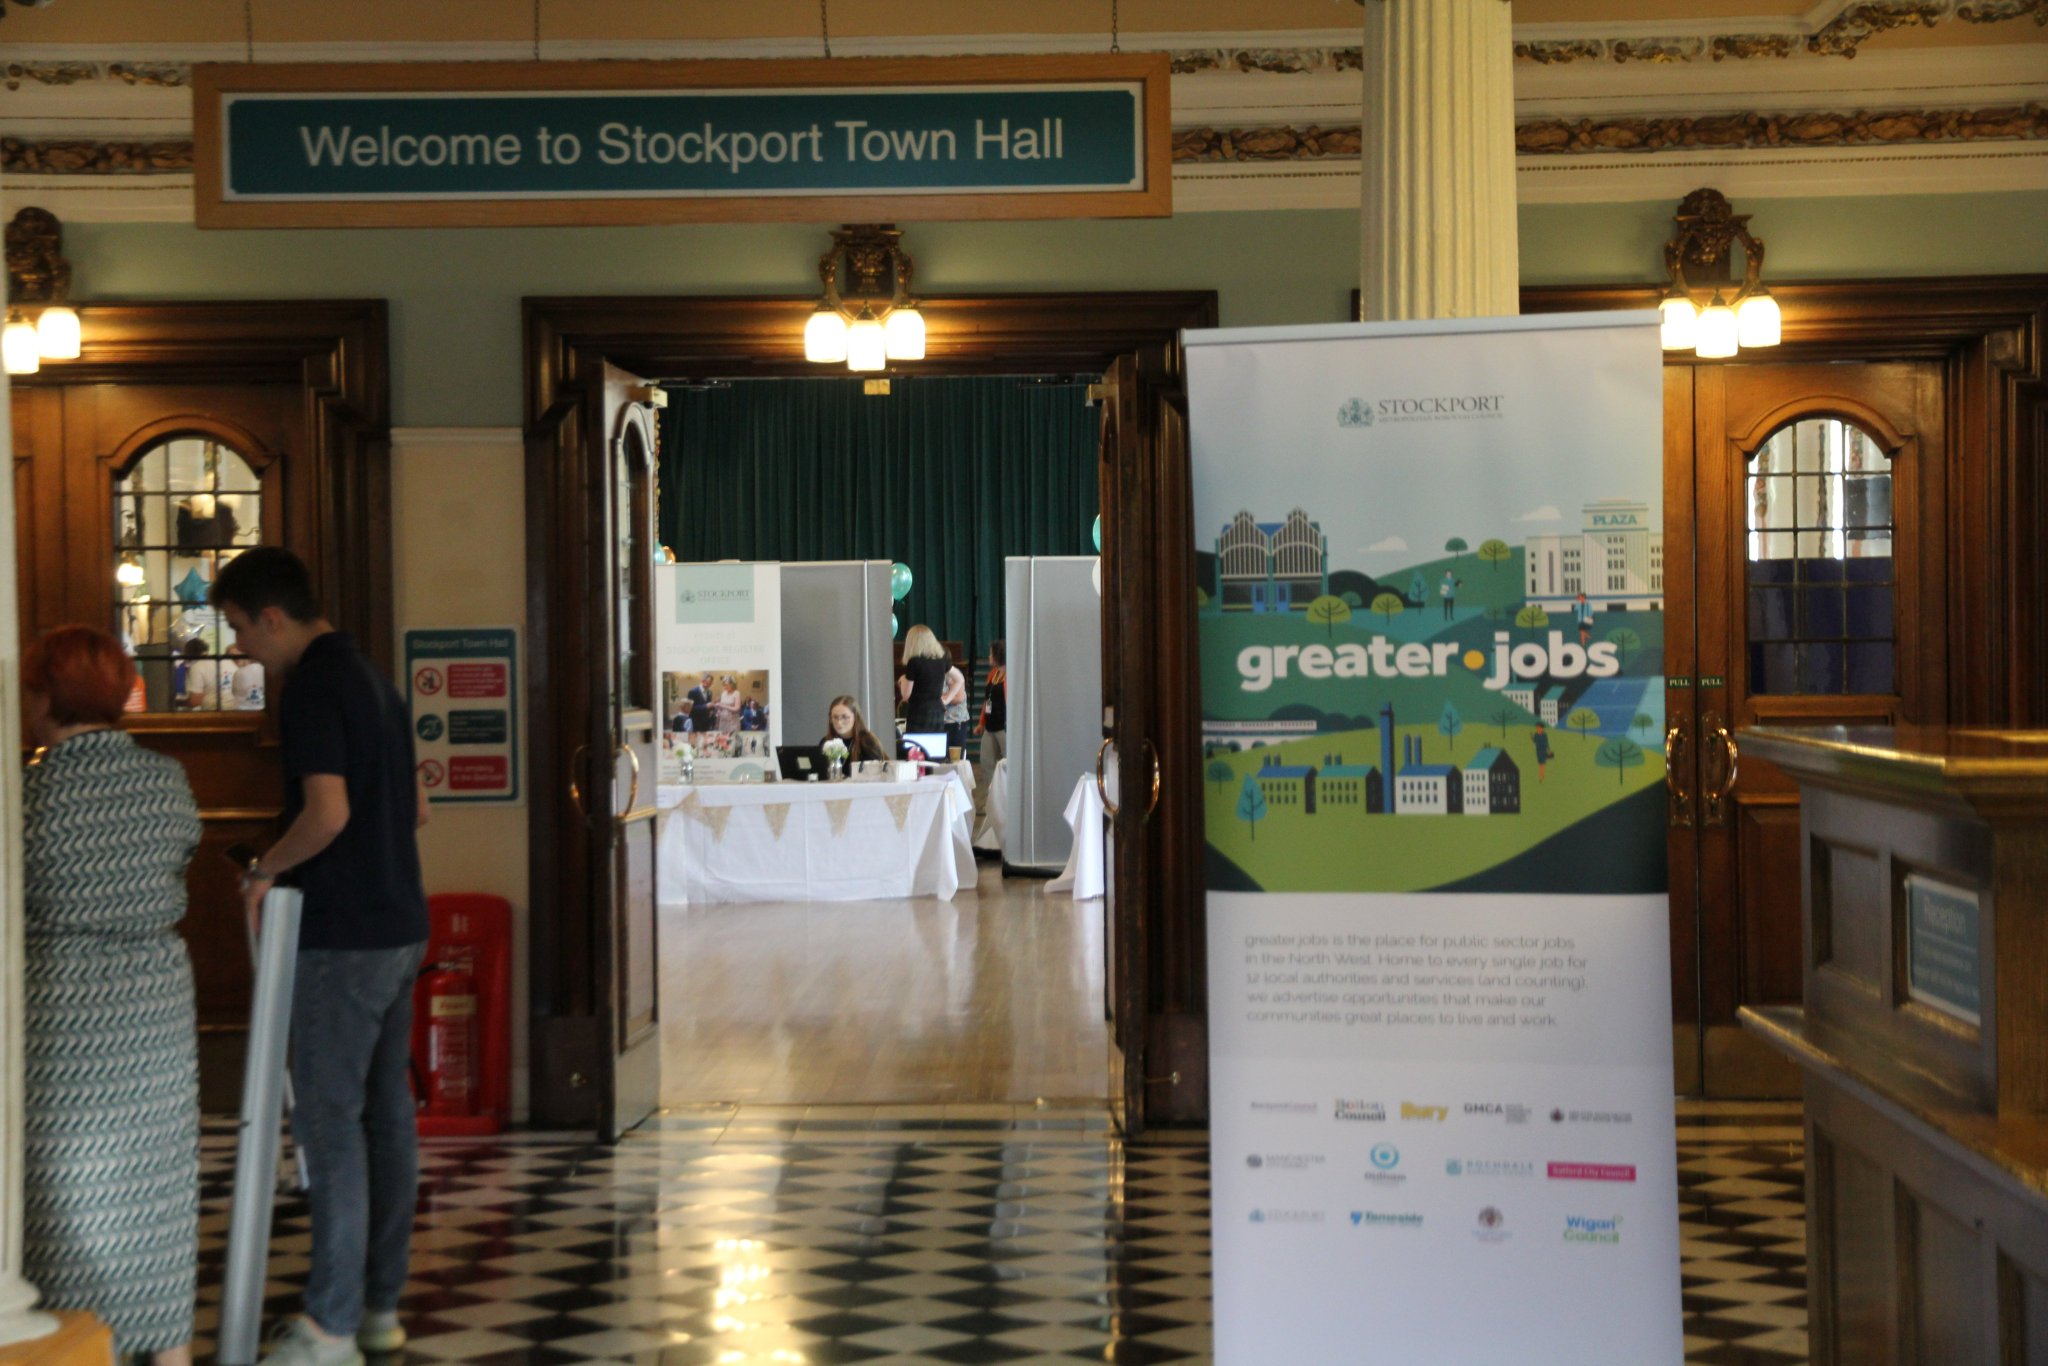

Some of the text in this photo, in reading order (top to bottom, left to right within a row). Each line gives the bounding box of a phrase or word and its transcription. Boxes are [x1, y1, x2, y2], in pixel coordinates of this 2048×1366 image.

[300, 118, 1065, 173] Welcome to Stockport Town Hall
[1379, 395, 1505, 415] STOCKPORT
[1592, 513, 1638, 526] PLAZA
[697, 589, 750, 598] STOCKPORT
[1669, 679, 1690, 687] PULL
[1701, 678, 1722, 686] PULL
[1333, 934, 1344, 946] is
[1347, 934, 1371, 946] the
[1375, 933, 1416, 949] place
[1420, 934, 1438, 947] for
[1443, 934, 1488, 950] public
[1493, 935, 1539, 948] sector
[1543, 935, 1575, 950] jobs
[1245, 953, 1258, 965] in
[1262, 953, 1285, 965] the
[1289, 953, 1330, 965] North
[1378, 954, 1424, 966] Home
[1429, 955, 1442, 967] to
[1447, 956, 1488, 970] every
[1492, 955, 1536, 970] single
[1540, 956, 1563, 970] job
[1568, 956, 1587, 969] for
[1264, 972, 1298, 984] local
[1302, 972, 1378, 985] authorities
[1382, 972, 1409, 985] and
[1414, 974, 1474, 986] services
[1247, 991, 1546, 1007] we advertise opportunities that make our
[1247, 1010, 1341, 1023] communities
[1345, 1011, 1382, 1026] great
[1387, 1010, 1436, 1026] places
[1439, 1012, 1454, 1025] to
[1457, 1012, 1483, 1025] live
[1487, 1013, 1516, 1026] and
[1334, 1099, 1385, 1111] Bolton
[1401, 1102, 1449, 1122] Bury
[1463, 1103, 1504, 1115] GMCA
[1335, 1110, 1386, 1122] Council
[1567, 1215, 1616, 1231] Wigan
[1563, 1229, 1620, 1244] Council
